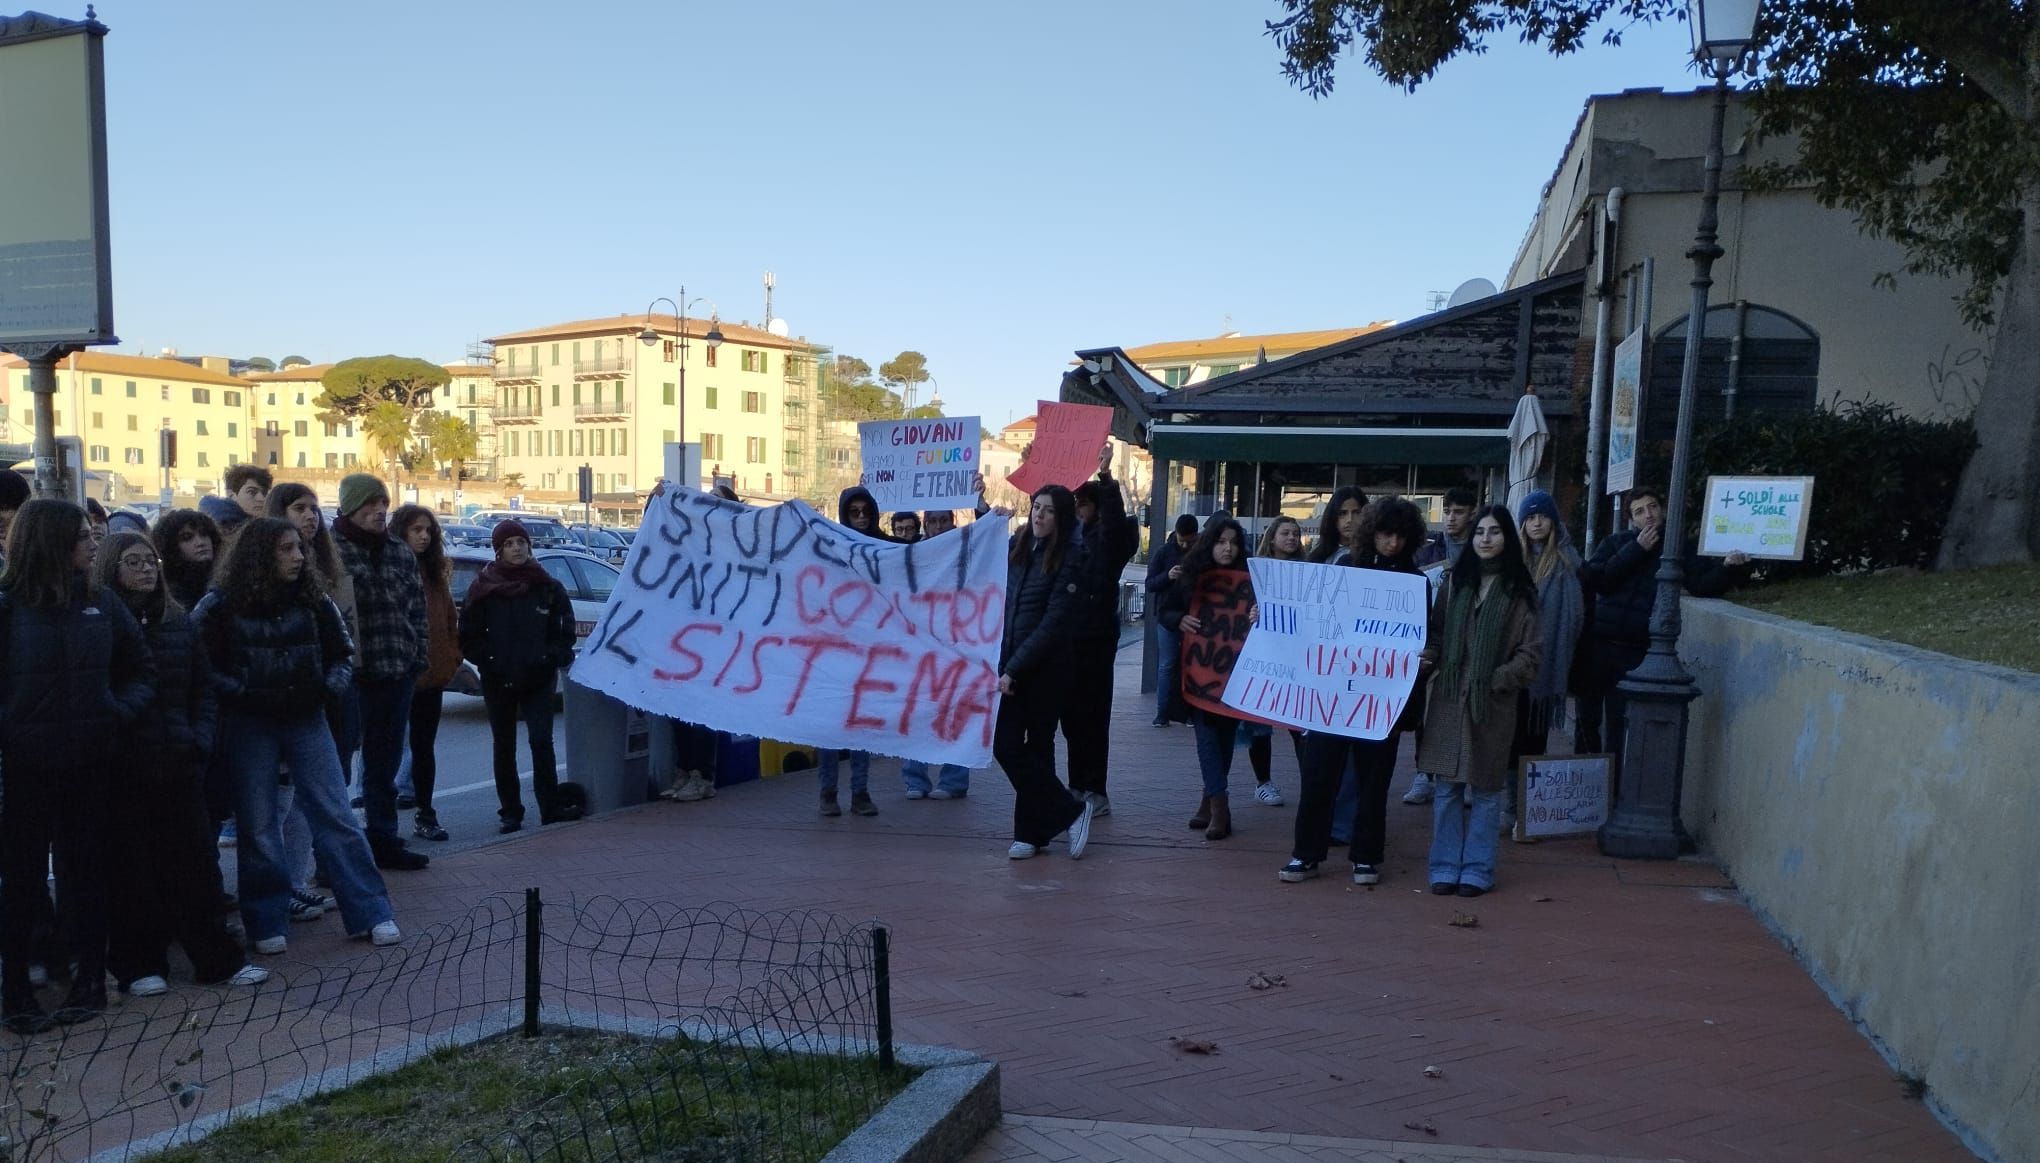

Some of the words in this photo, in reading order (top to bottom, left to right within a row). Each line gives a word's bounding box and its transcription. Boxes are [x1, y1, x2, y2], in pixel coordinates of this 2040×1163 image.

[891, 422, 963, 446] GIOVANI
[916, 447, 973, 465] FUTURO
[876, 470, 895, 483] NON
[1751, 505, 1786, 516] SCUOLE
[631, 545, 782, 626] UNITI
[794, 564, 1002, 648] CONTRO
[590, 600, 644, 665] IL
[652, 622, 999, 749] SISTEMA
[1347, 679, 1356, 692] E
